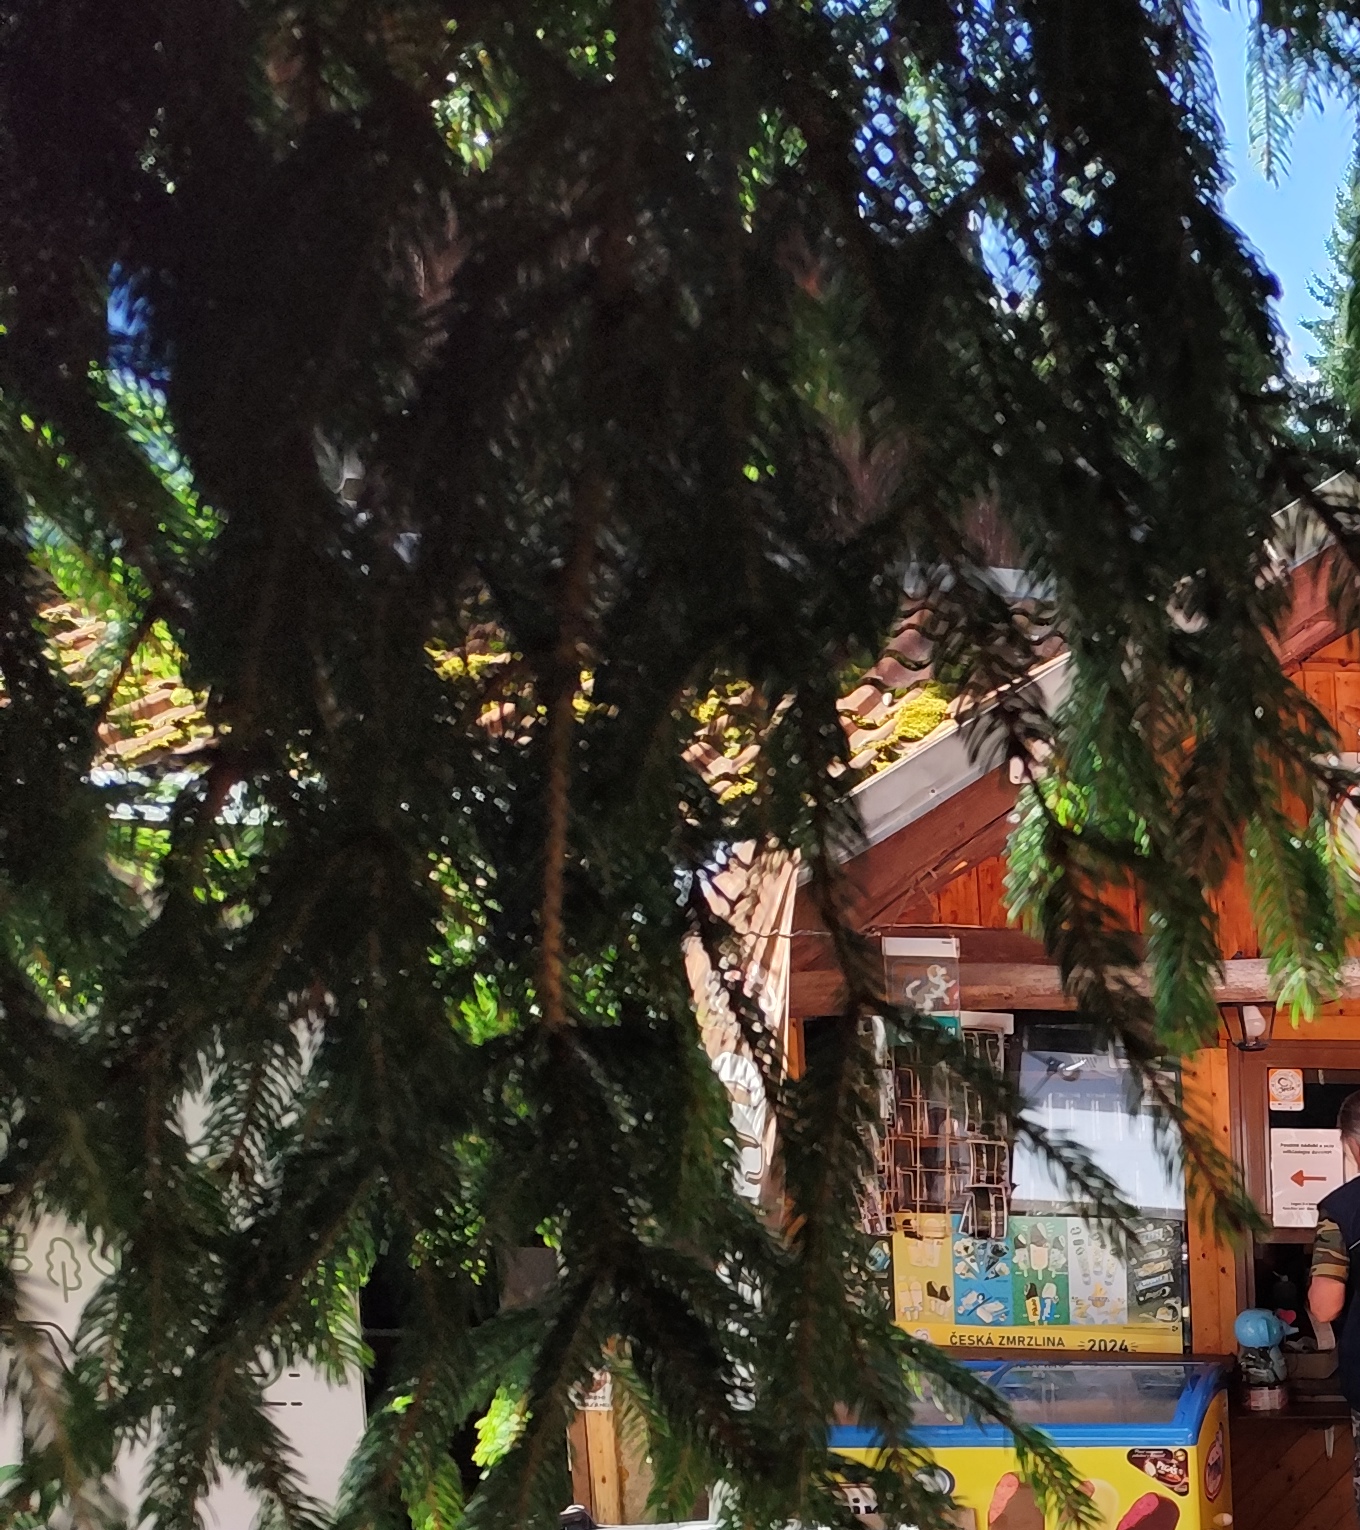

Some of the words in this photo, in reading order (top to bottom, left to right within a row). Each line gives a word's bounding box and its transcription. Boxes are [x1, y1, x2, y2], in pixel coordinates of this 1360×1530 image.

[949, 1331, 995, 1347] ČESKÁ
[998, 1335, 1066, 1349] ZMRZLINA
[1087, 1338, 1130, 1353] 2024
